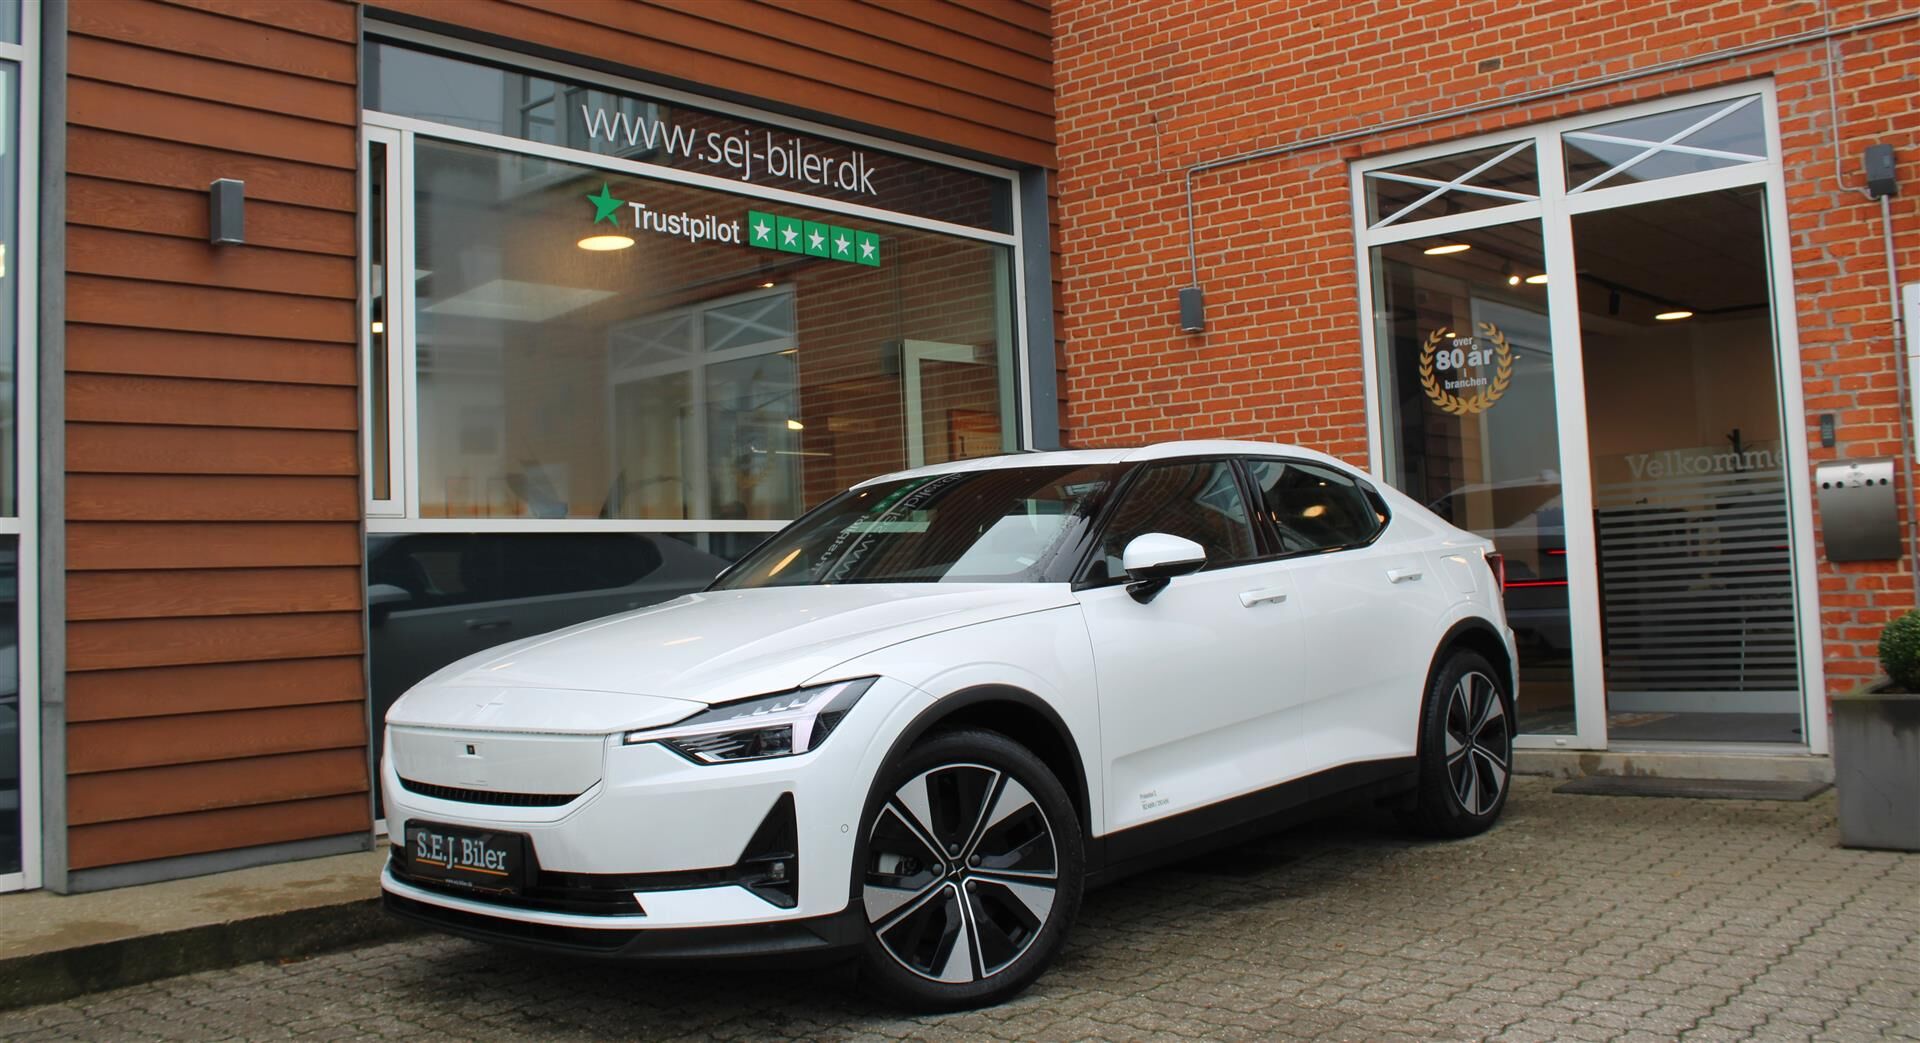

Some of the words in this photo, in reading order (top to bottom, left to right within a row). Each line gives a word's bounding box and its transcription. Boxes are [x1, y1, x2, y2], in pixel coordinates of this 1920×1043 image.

[582, 104, 877, 195] www.sej-biler.dk
[628, 201, 740, 244] Trustpilot
[1436, 349, 1465, 370] 80
[1468, 344, 1493, 366] år
[1453, 337, 1473, 347] over
[1445, 377, 1487, 389] branchen
[417, 832, 458, 869] S.E.J.
[462, 838, 507, 870] Biler
